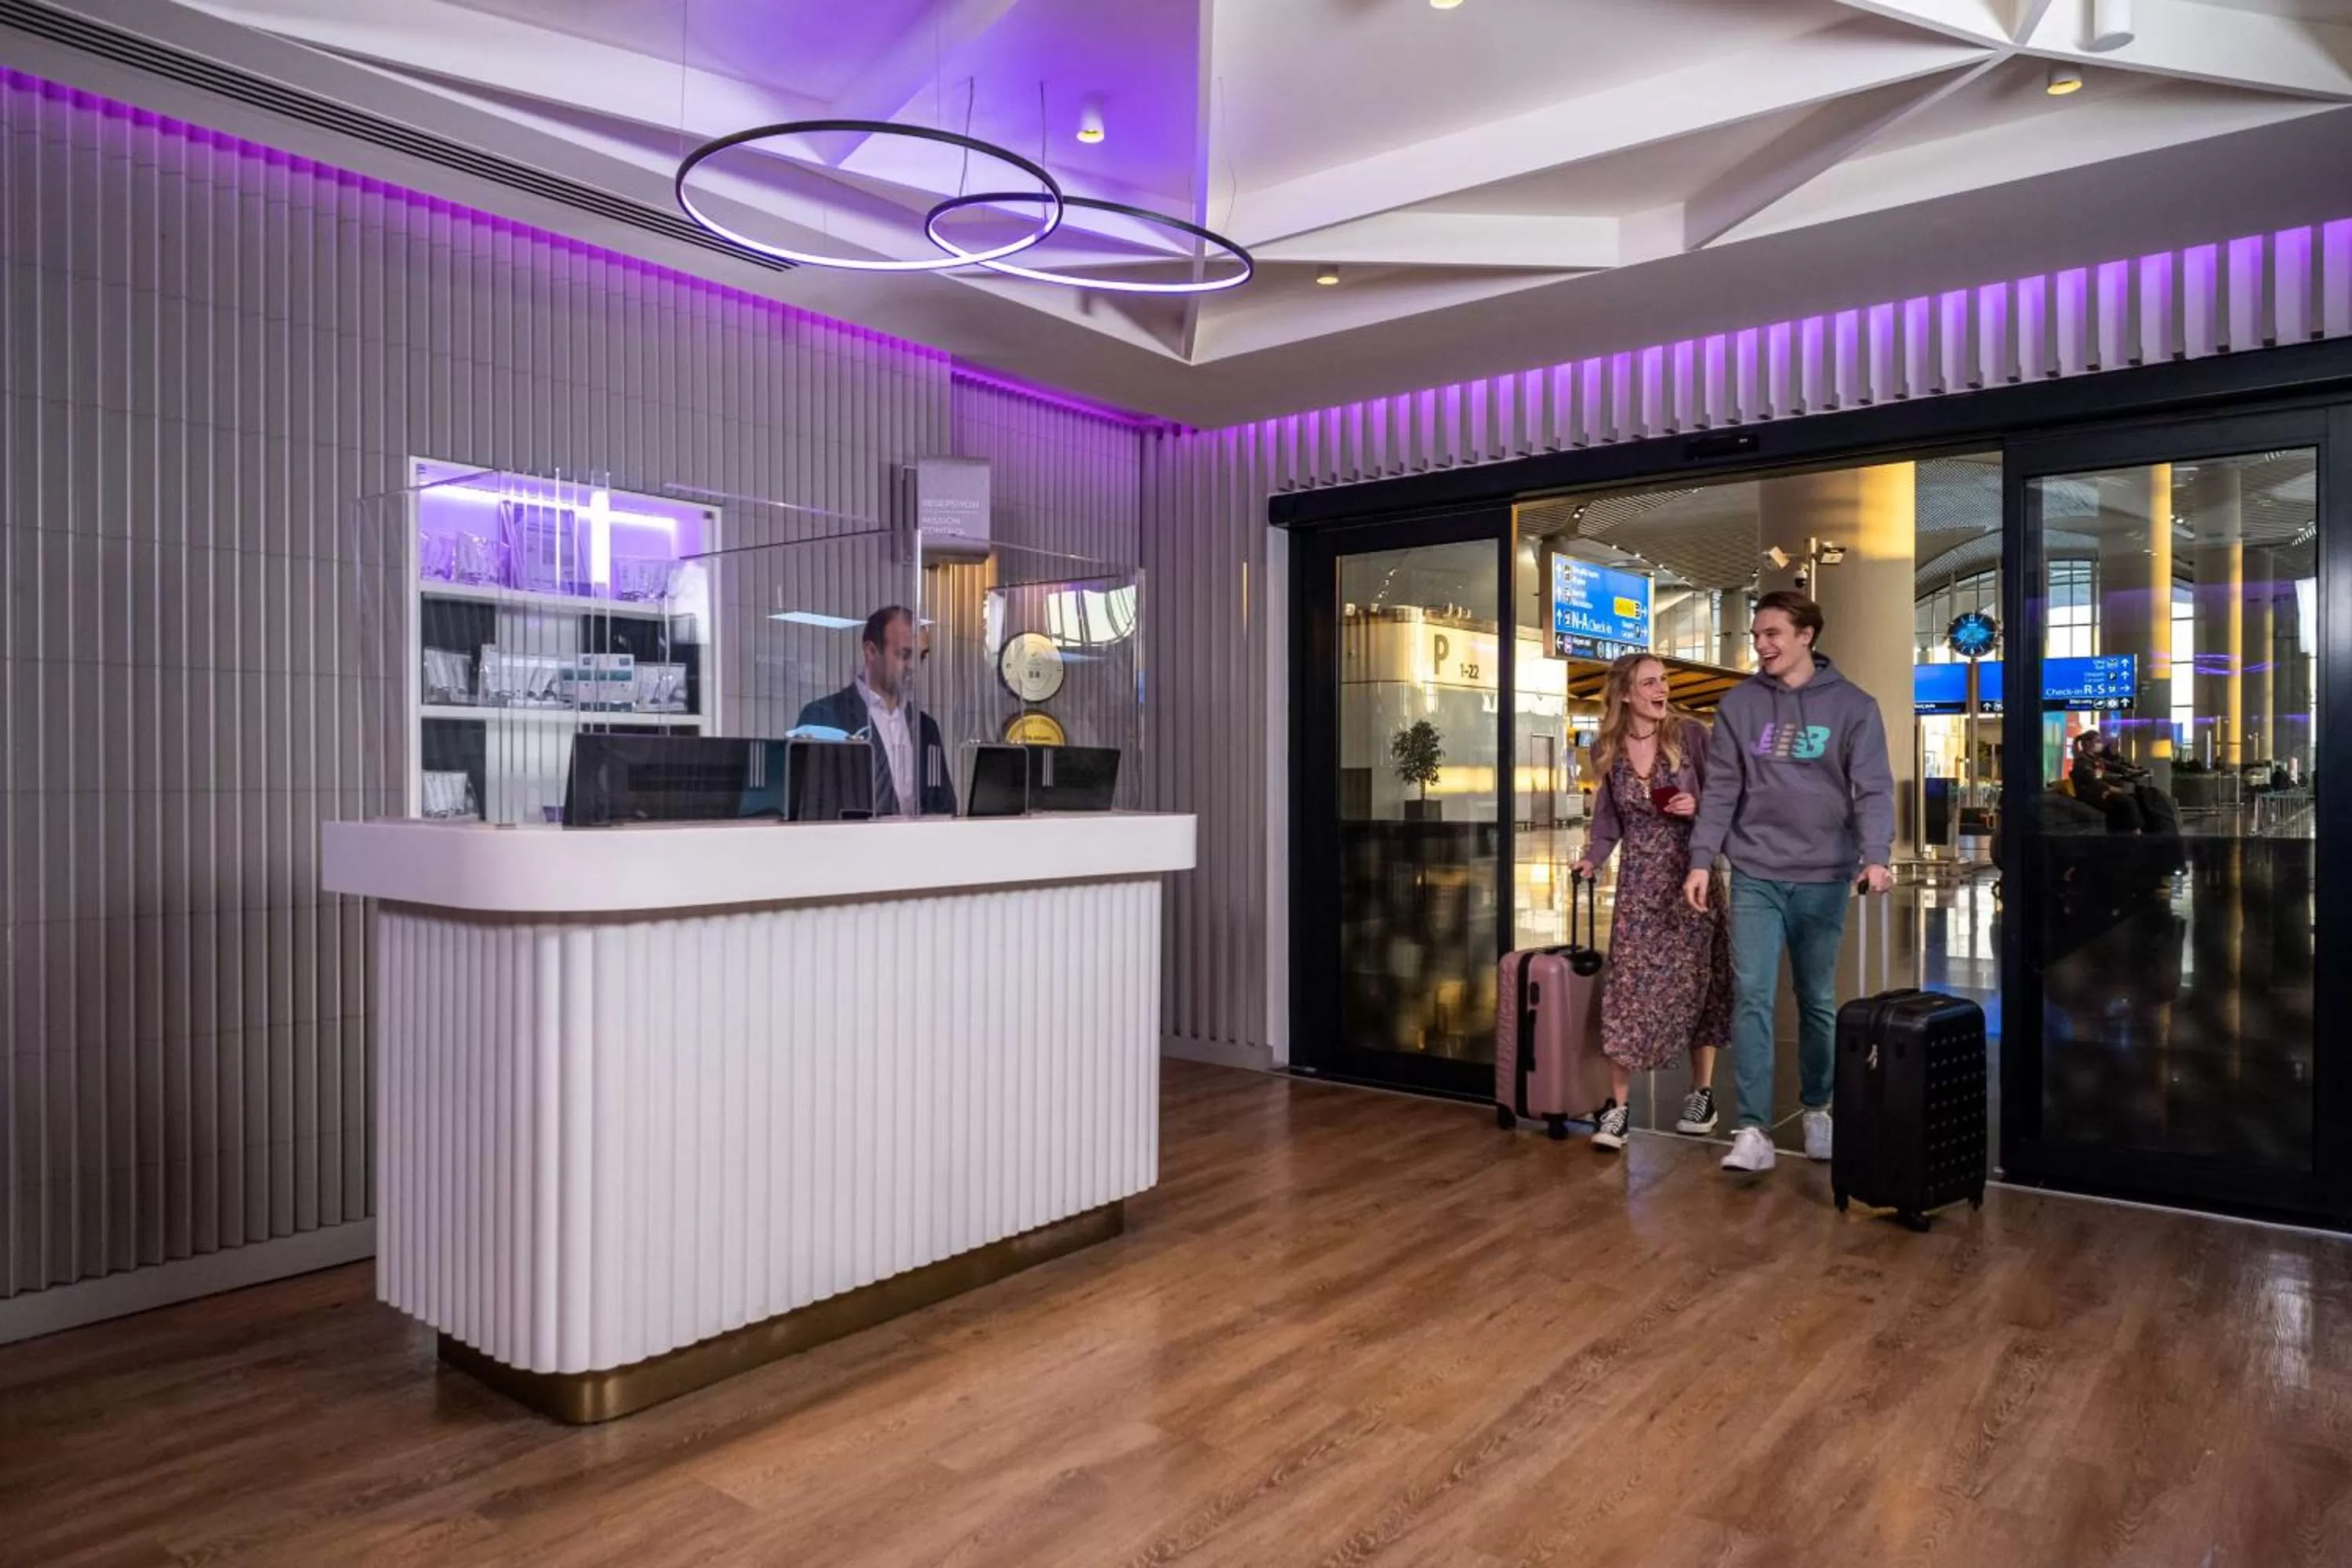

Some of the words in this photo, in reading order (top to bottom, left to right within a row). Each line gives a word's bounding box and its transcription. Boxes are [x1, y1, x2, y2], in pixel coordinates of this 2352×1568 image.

[1433, 633, 1450, 675] P
[1460, 663, 1479, 680] 1-22
[2083, 684, 2105, 695] R-S
